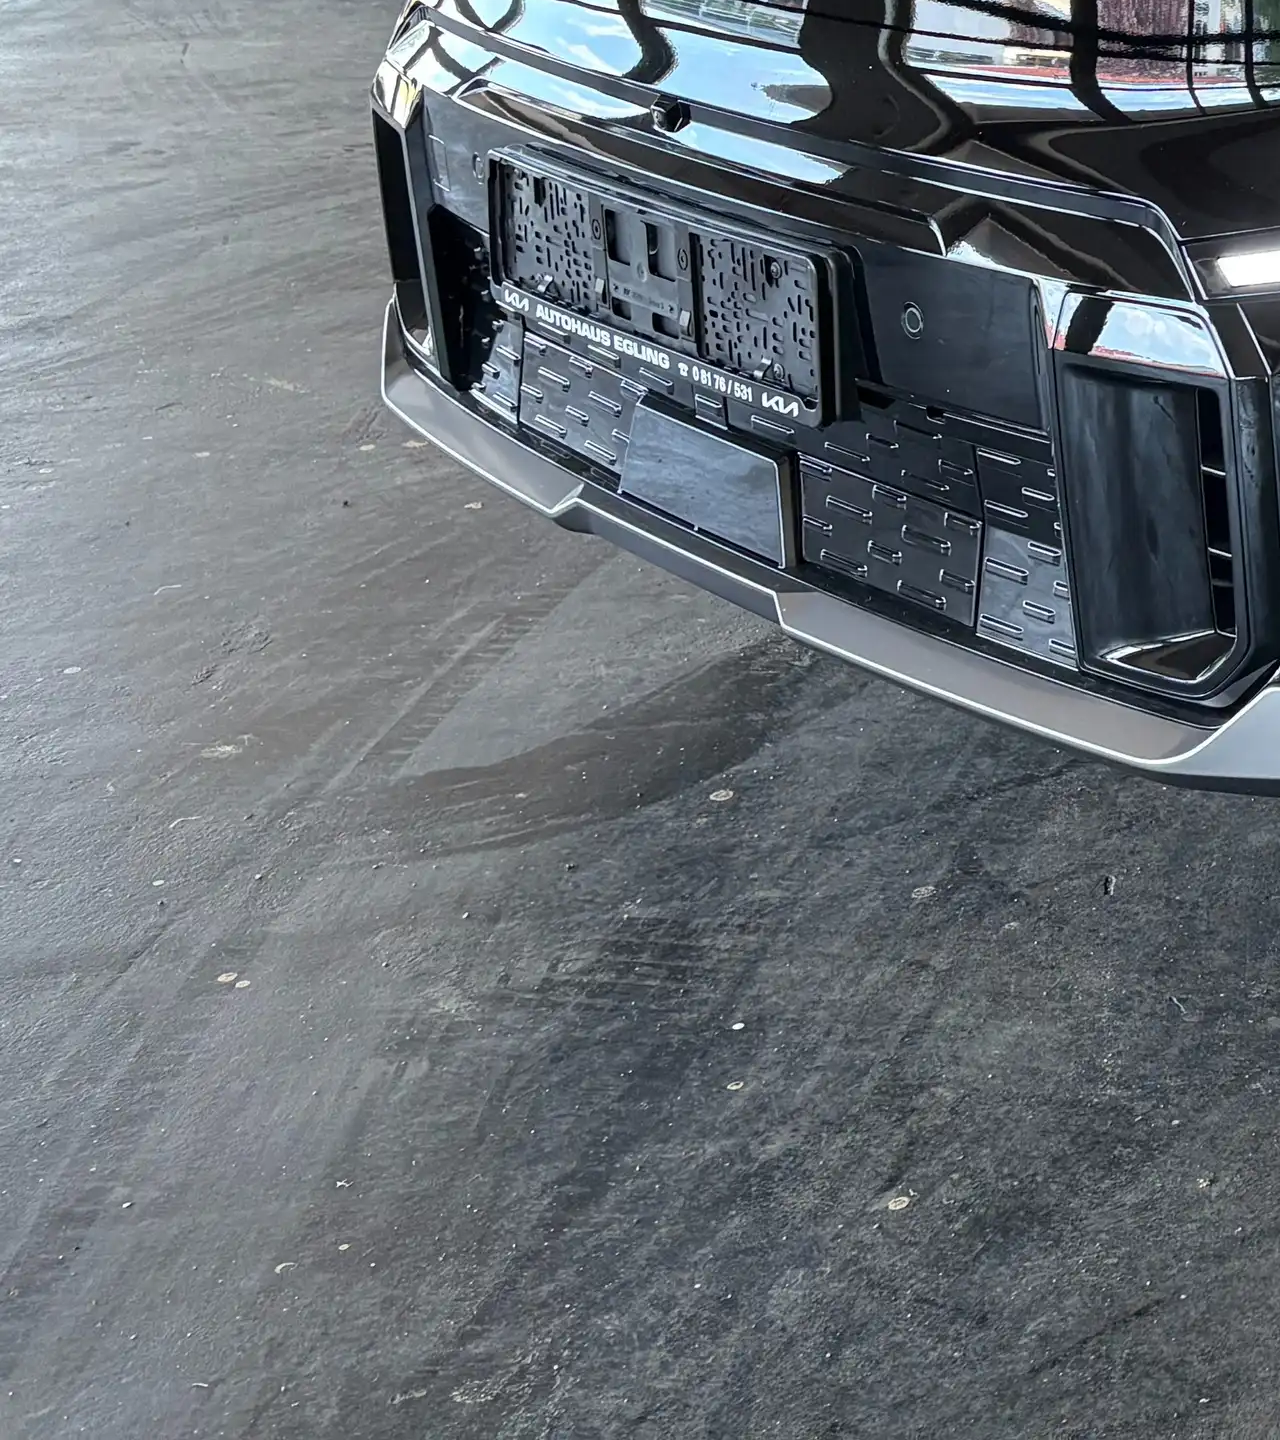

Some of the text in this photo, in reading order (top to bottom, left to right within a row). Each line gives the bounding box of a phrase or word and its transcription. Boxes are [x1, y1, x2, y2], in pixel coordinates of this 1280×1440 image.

[503, 288, 530, 313] KIA
[535, 302, 612, 348] AUTOHAUS
[613, 334, 671, 370] EGLING
[761, 391, 799, 417] KIA
